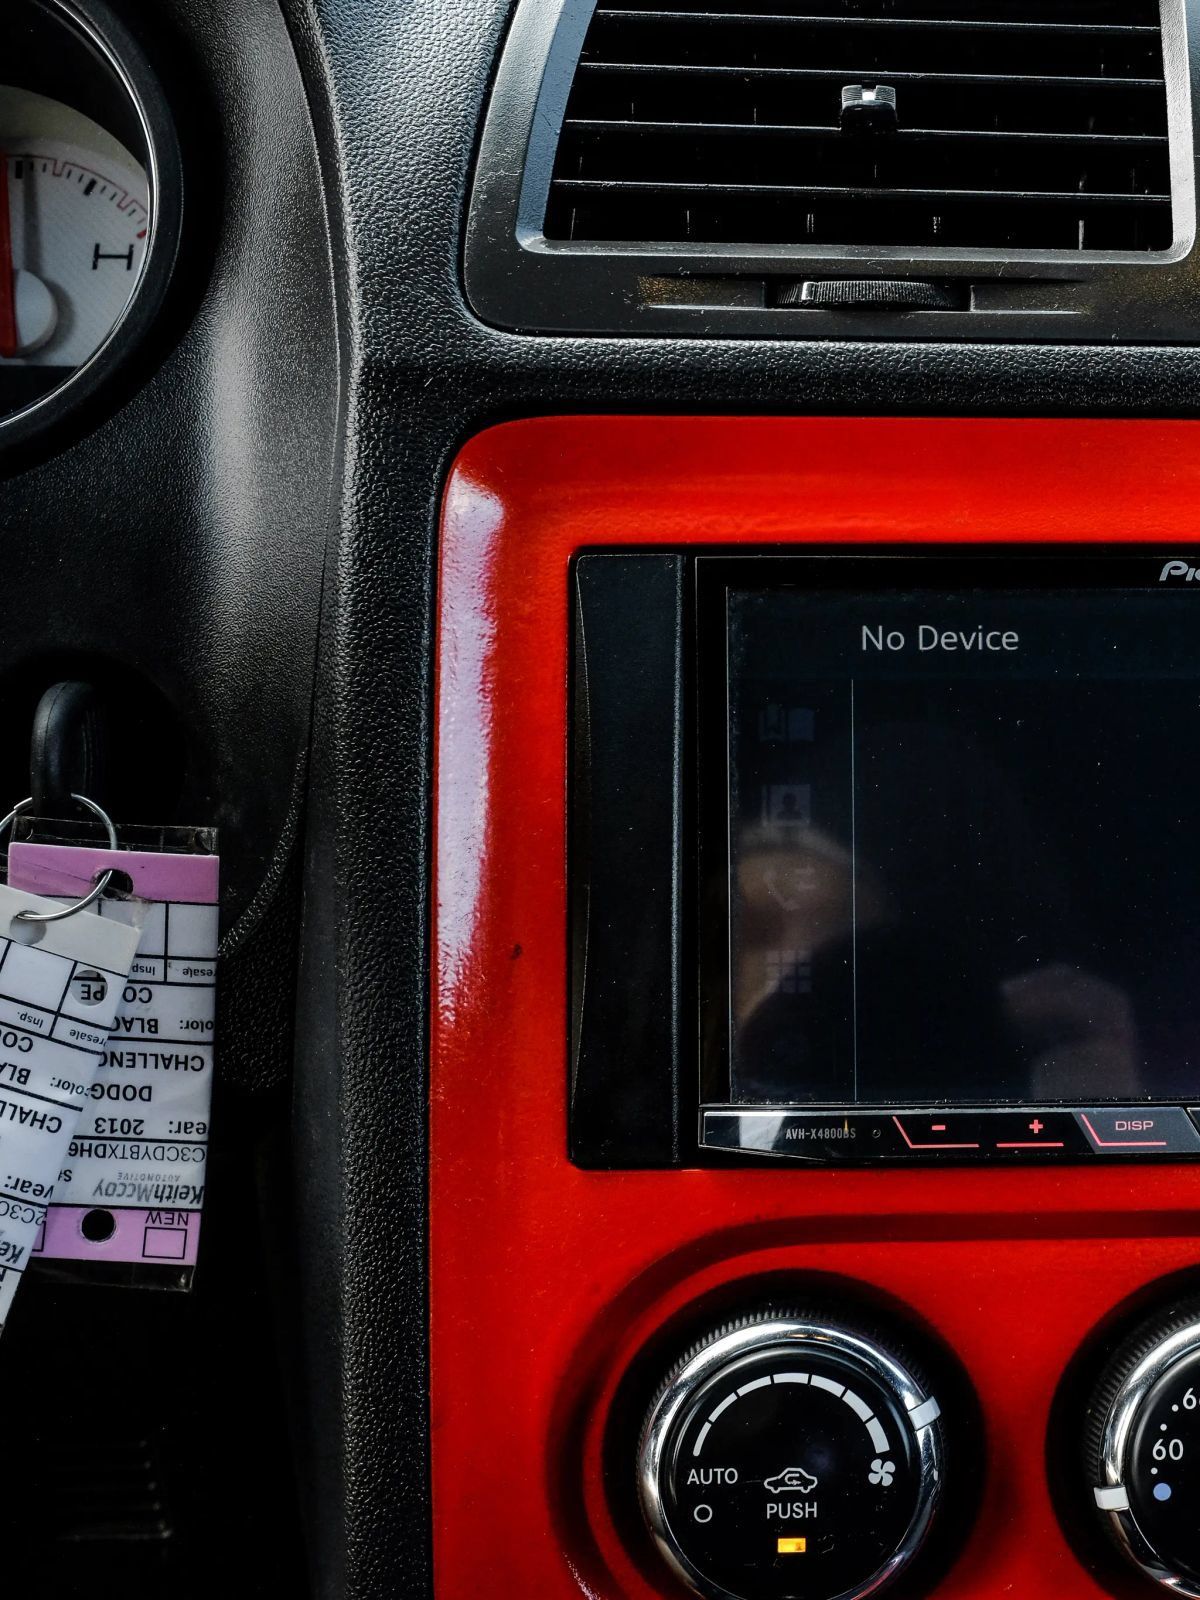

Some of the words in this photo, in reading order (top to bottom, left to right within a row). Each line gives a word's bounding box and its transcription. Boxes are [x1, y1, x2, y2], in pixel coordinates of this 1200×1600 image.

[861, 625, 905, 651] No
[918, 625, 1019, 651] Device
[111, 1015, 159, 1034] BLAC
[179, 1016, 214, 1031] olor:
[0, 1029, 34, 1053] CO
[90, 1083, 152, 1102] DODG
[94, 1117, 145, 1136] 2013
[168, 1119, 208, 1136] ear:
[785, 1128, 856, 1140] AVH-X4800BS
[1115, 1120, 1154, 1131] DISP
[68, 1141, 206, 1163] C3CDYBTXDH6
[145, 1210, 190, 1226] NEW
[1152, 1439, 1184, 1460] 60
[687, 1468, 738, 1485] AUTO
[766, 1502, 817, 1519] PUSH
